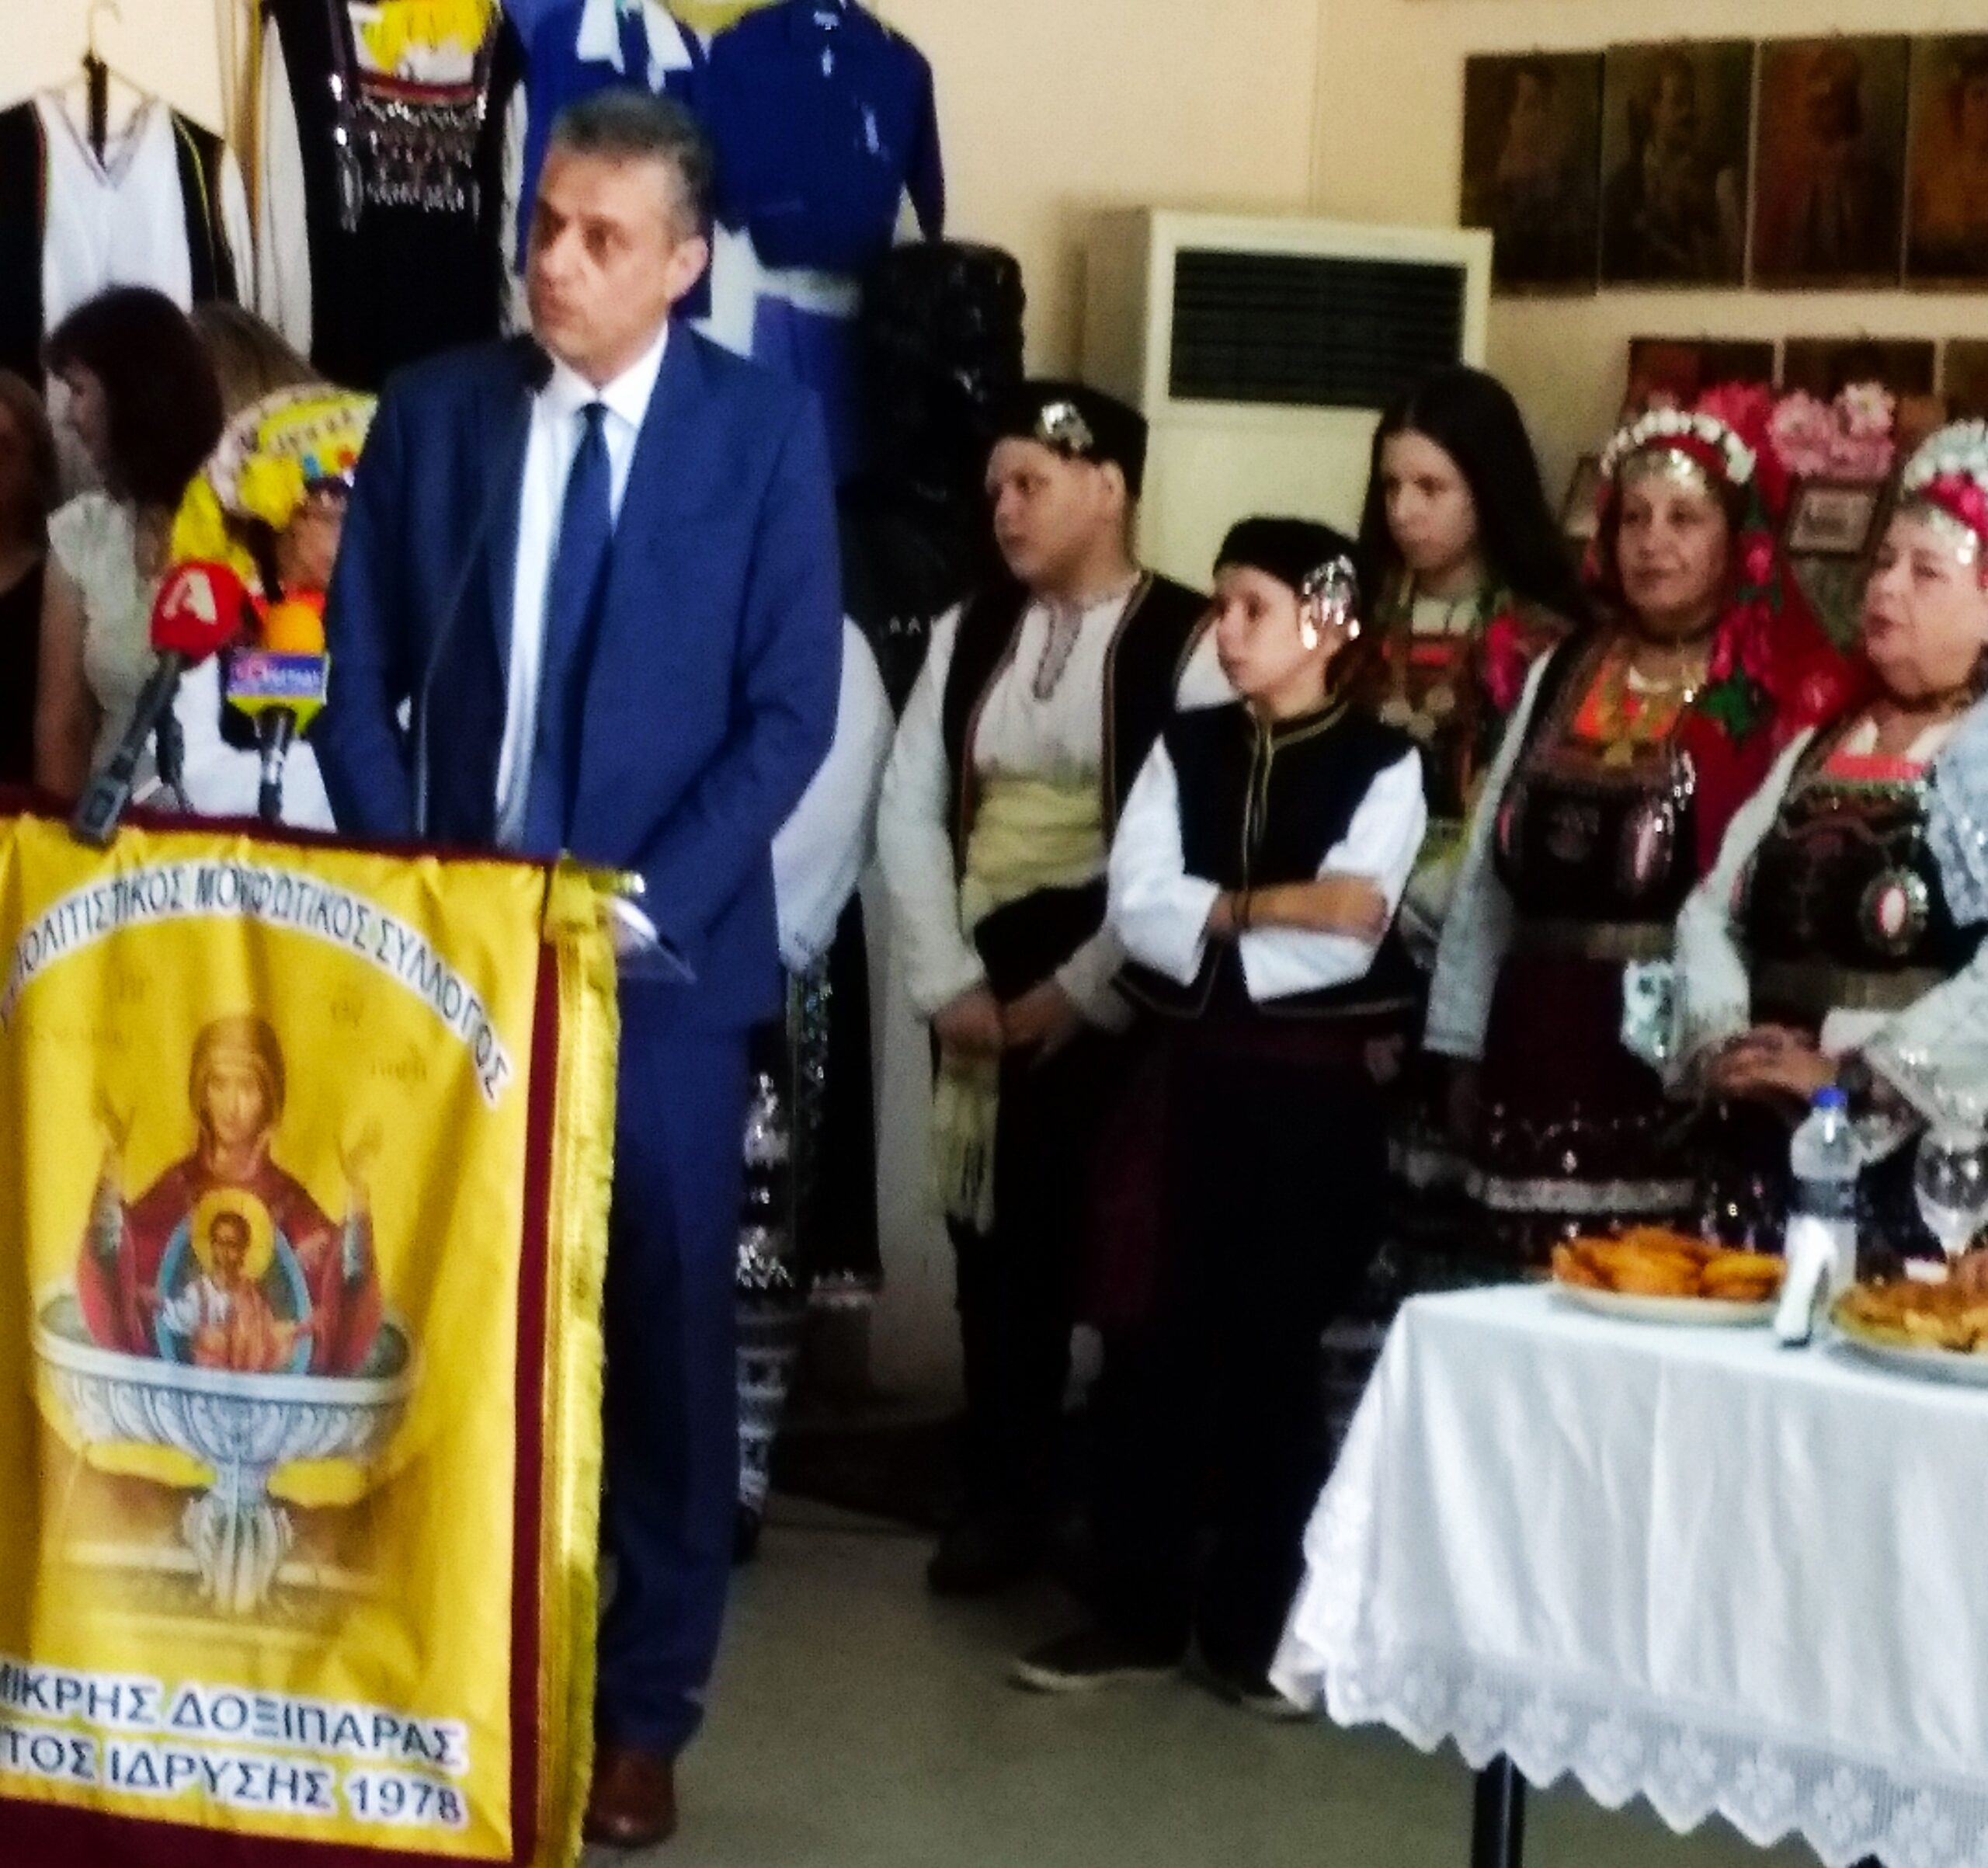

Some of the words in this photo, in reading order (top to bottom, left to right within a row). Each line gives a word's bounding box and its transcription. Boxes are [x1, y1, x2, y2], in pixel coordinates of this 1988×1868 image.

[376, 918, 509, 1100] ΣΥΛΛΟΓΟΣ
[172, 1692, 461, 1766] ΔΟΞΙΠΑΡΑΣ
[112, 1750, 330, 1808] ΙΔΡΥΣΗΣ
[352, 1776, 461, 1823] 1978
